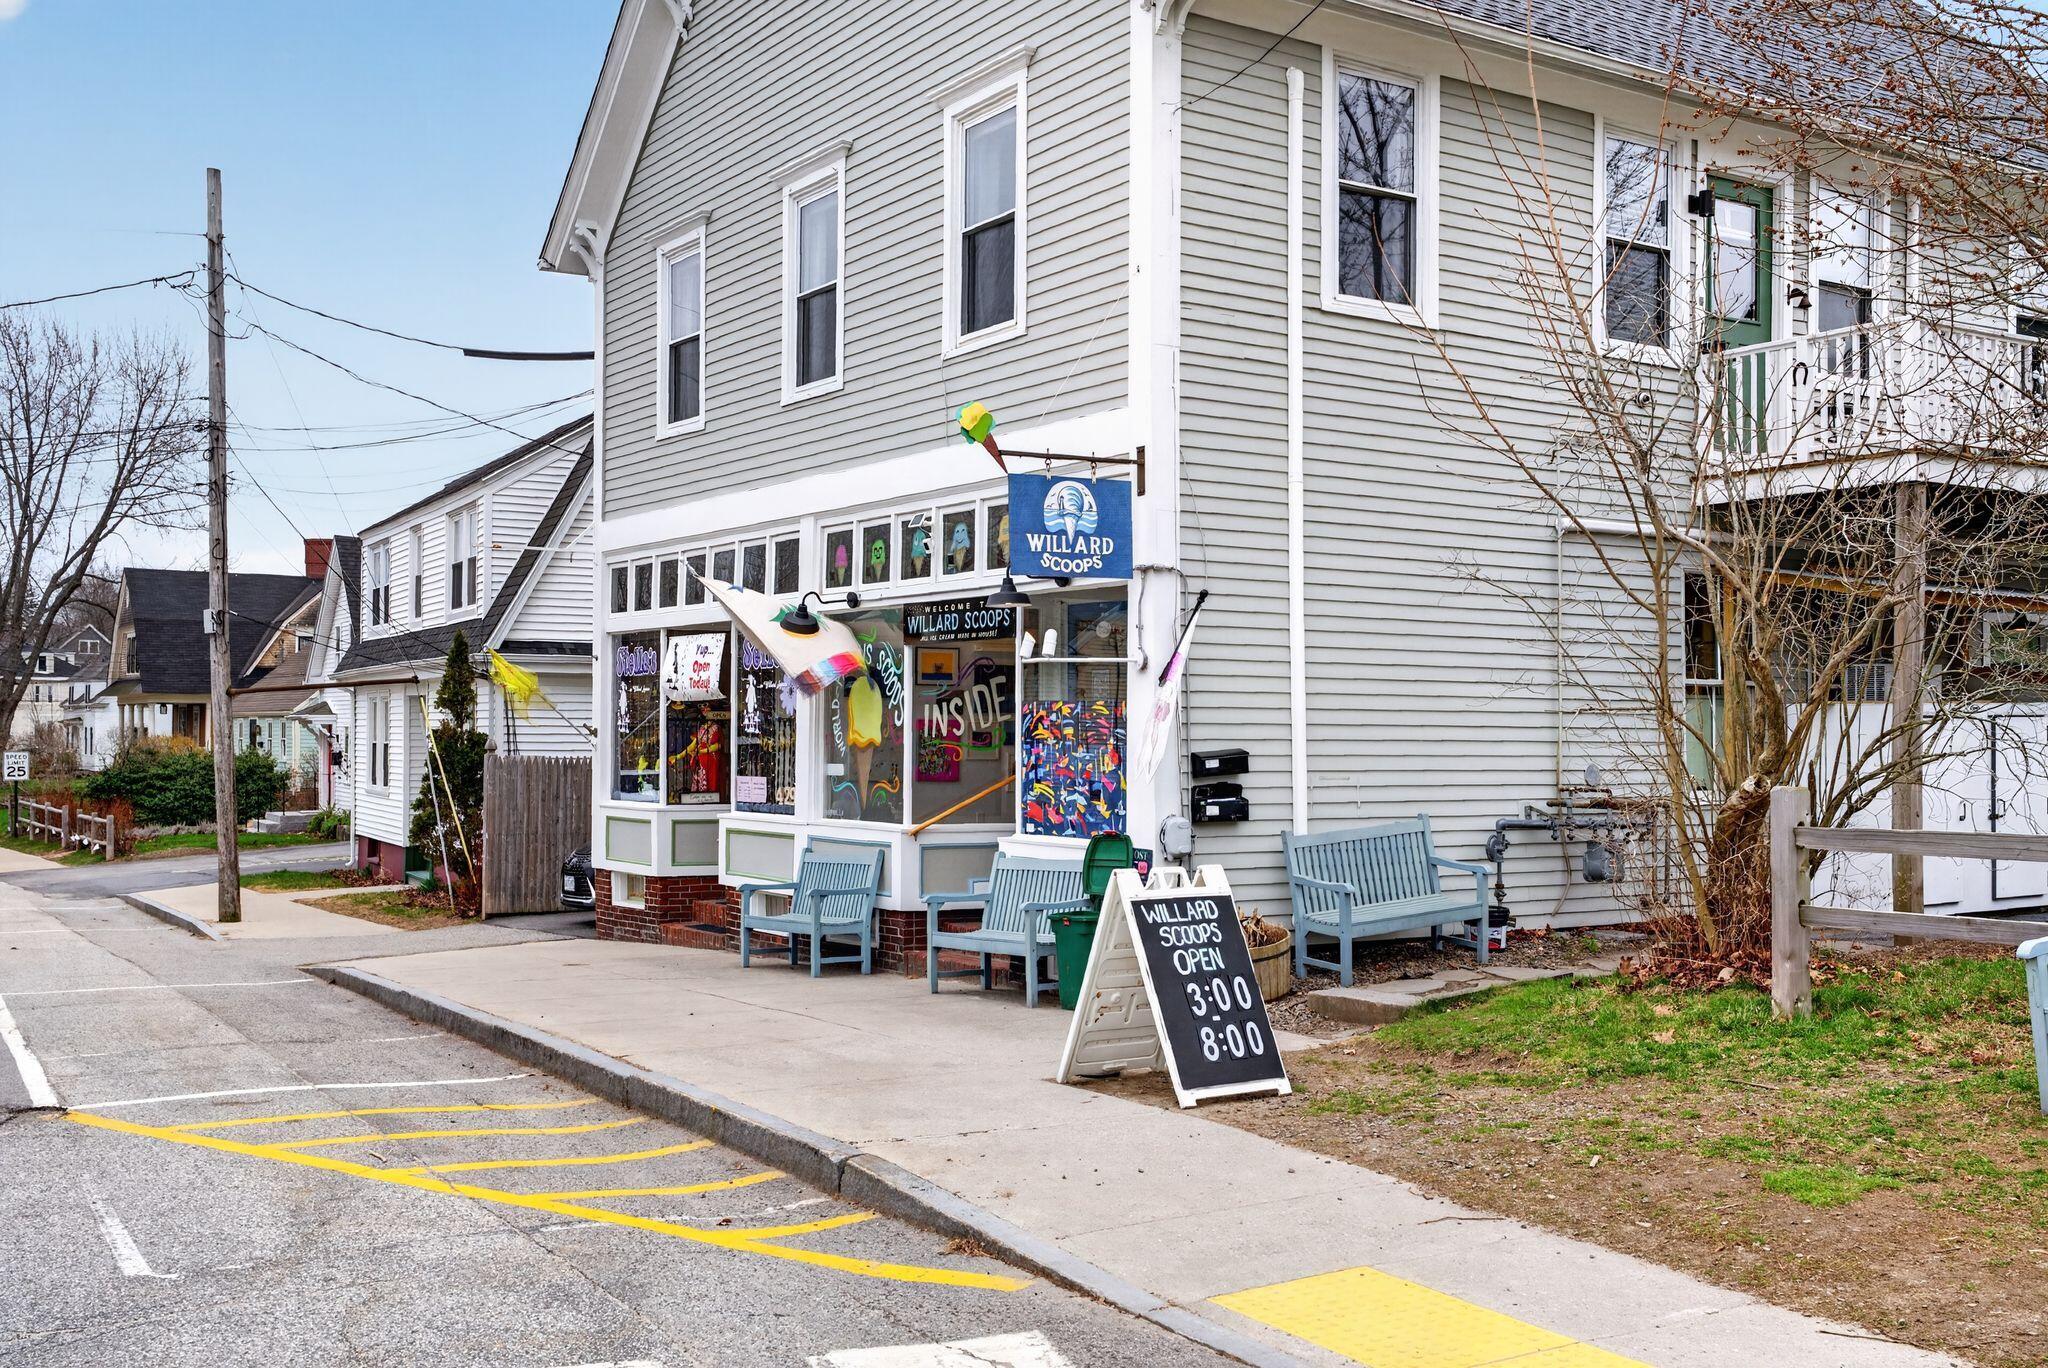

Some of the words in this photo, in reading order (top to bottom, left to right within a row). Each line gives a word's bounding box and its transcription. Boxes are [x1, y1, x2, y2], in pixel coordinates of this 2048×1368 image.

[1026, 533, 1114, 555] WILLARD
[1041, 552, 1103, 573] SCOOPS
[925, 602, 971, 613] WELCOME
[907, 613, 959, 634] WILLARD
[965, 608, 1011, 629] SCOOPS
[693, 660, 711, 677] Open
[689, 675, 711, 694] Today!
[876, 649, 905, 727] SCOOPS
[923, 675, 1012, 738] INSIDE
[6, 766, 26, 777] 25
[1141, 900, 1219, 924] WILLARD
[1159, 922, 1222, 947] SCOOPS
[1173, 947, 1225, 976] OPEN
[1186, 976, 1252, 1017] 3:00
[1200, 1021, 1265, 1062] 8:00
